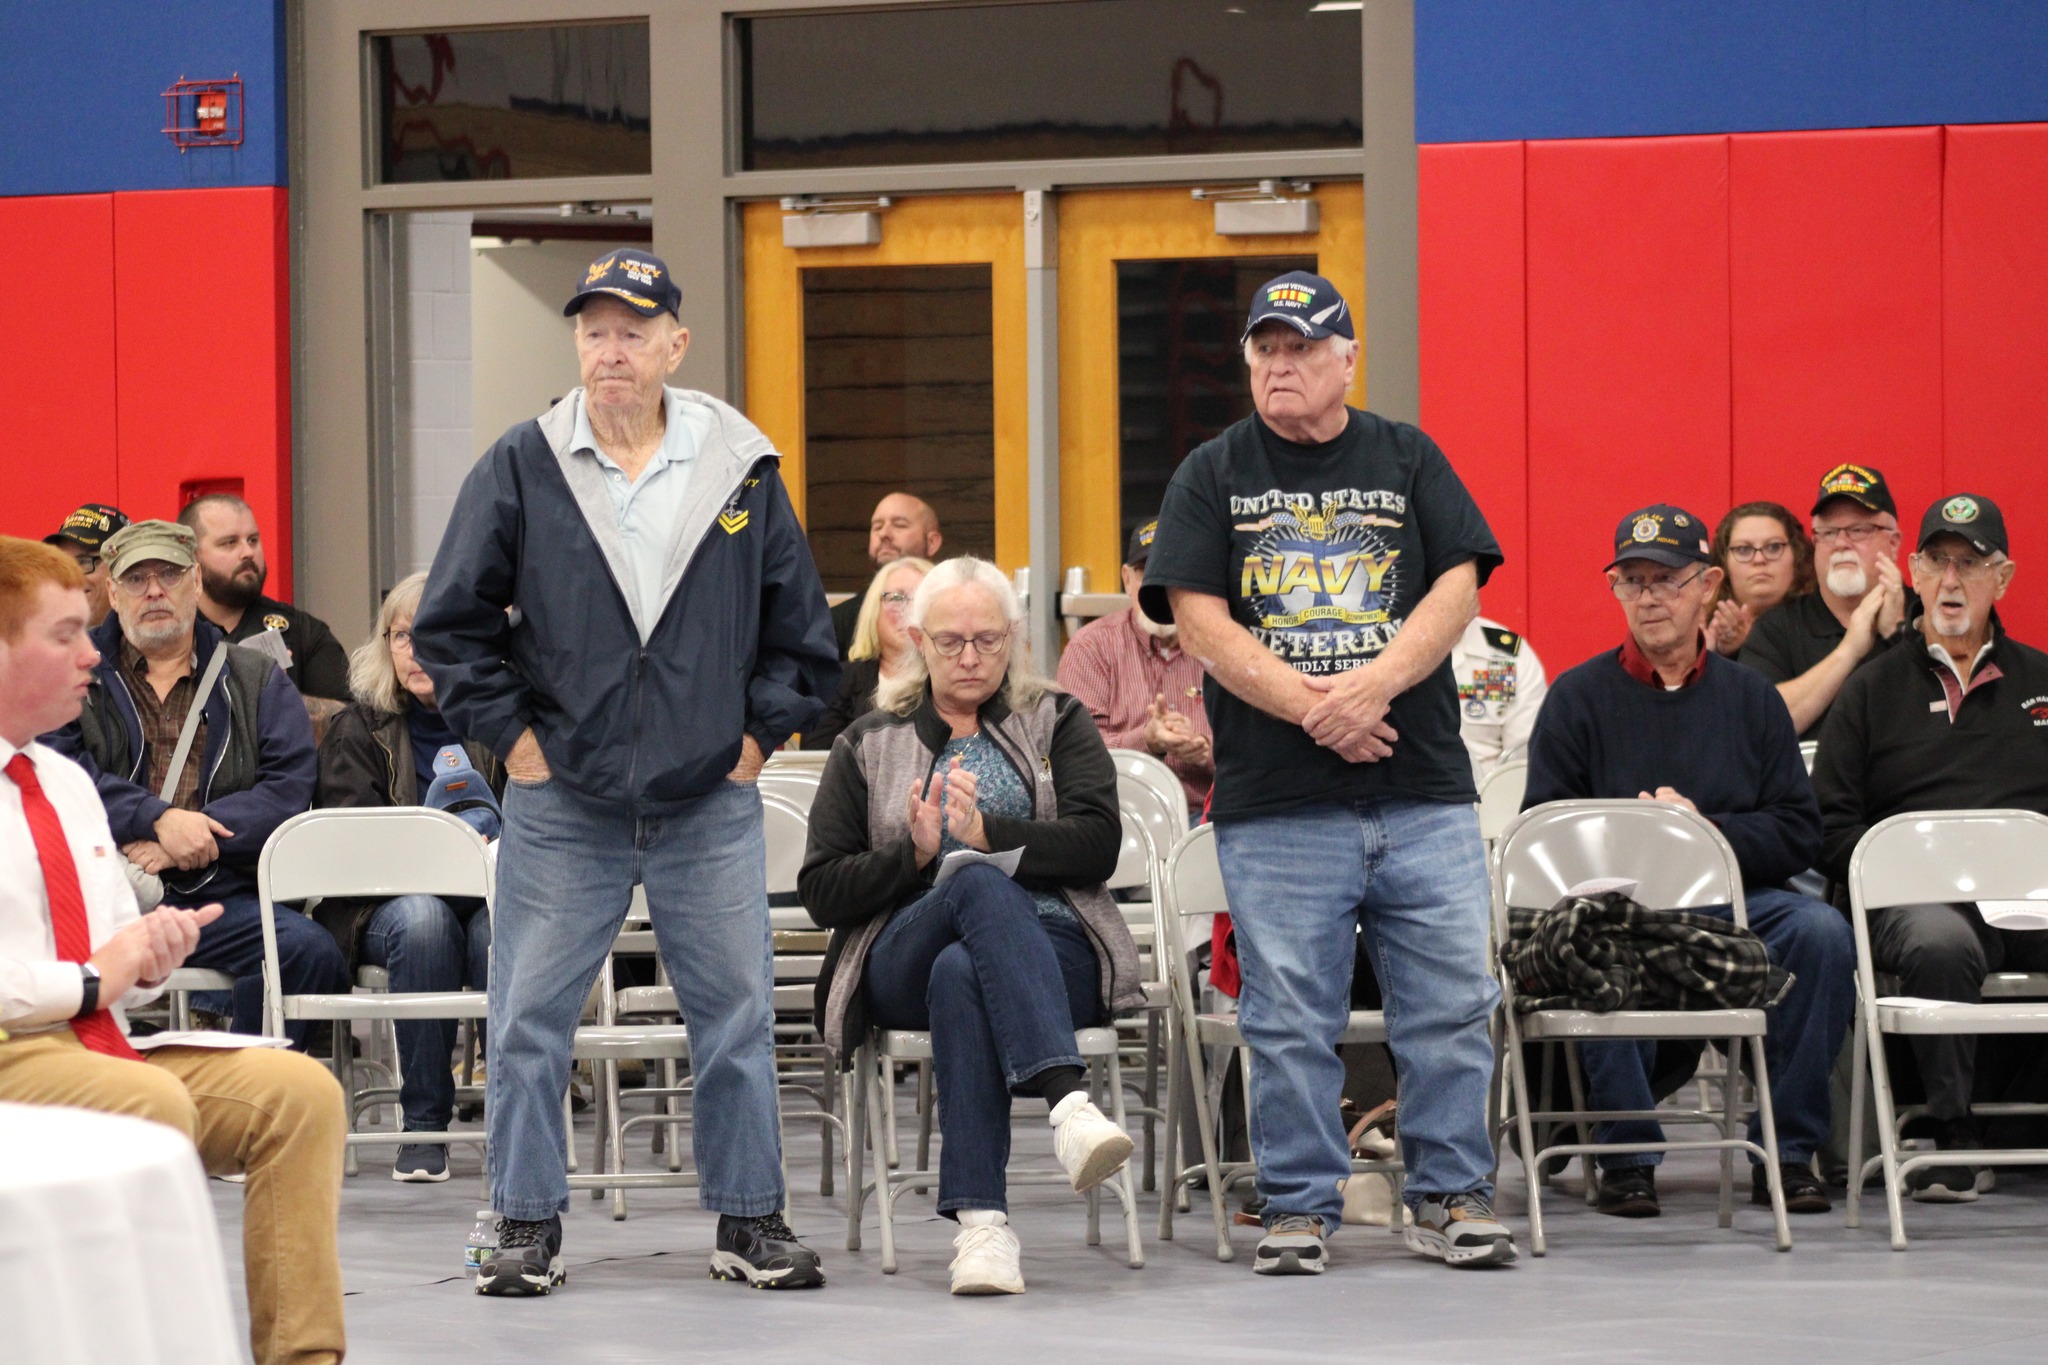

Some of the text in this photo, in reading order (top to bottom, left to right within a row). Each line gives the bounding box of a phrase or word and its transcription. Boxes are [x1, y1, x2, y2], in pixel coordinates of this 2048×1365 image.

[619, 261, 662, 278] NAVY
[1267, 283, 1316, 295] VIETNAM VETERAN
[1284, 300, 1302, 309] NAVY
[1848, 464, 1878, 484] STORM
[1827, 483, 1866, 494] VETERAN
[1230, 487, 1406, 516] UNITED STATES
[1241, 550, 1401, 598] NAVY
[1271, 608, 1380, 626] HONOR COURAGE COMMITMENT
[1249, 618, 1402, 658] VETERAN
[1291, 660, 1332, 673] UDLY
[2021, 698, 2036, 709] BAR
